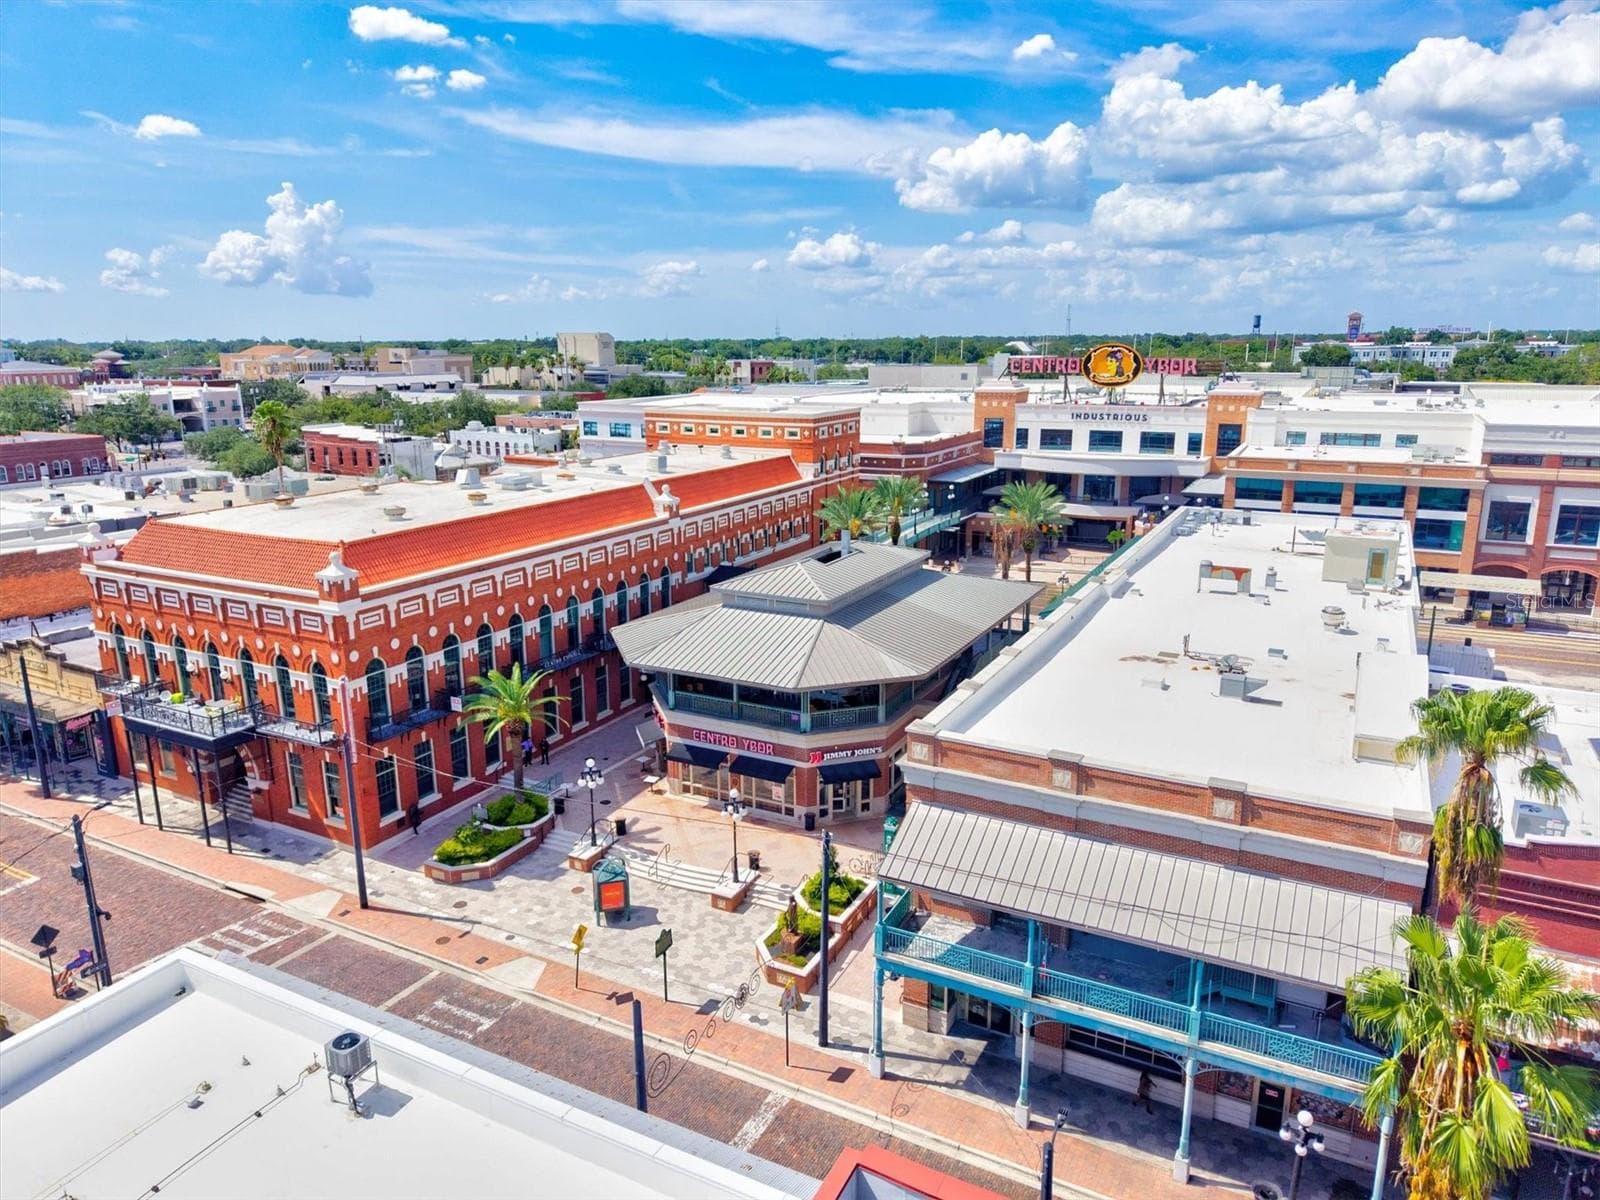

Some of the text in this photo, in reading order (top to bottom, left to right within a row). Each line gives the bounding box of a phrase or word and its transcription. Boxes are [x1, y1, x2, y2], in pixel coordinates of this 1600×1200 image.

[1010, 357, 1197, 375] CENTRO YBOR
[1071, 412, 1149, 422] INDUSTRIOUS
[693, 729, 775, 755] CENTRO YBOR
[823, 746, 882, 761] JIMMY JOHN'S
